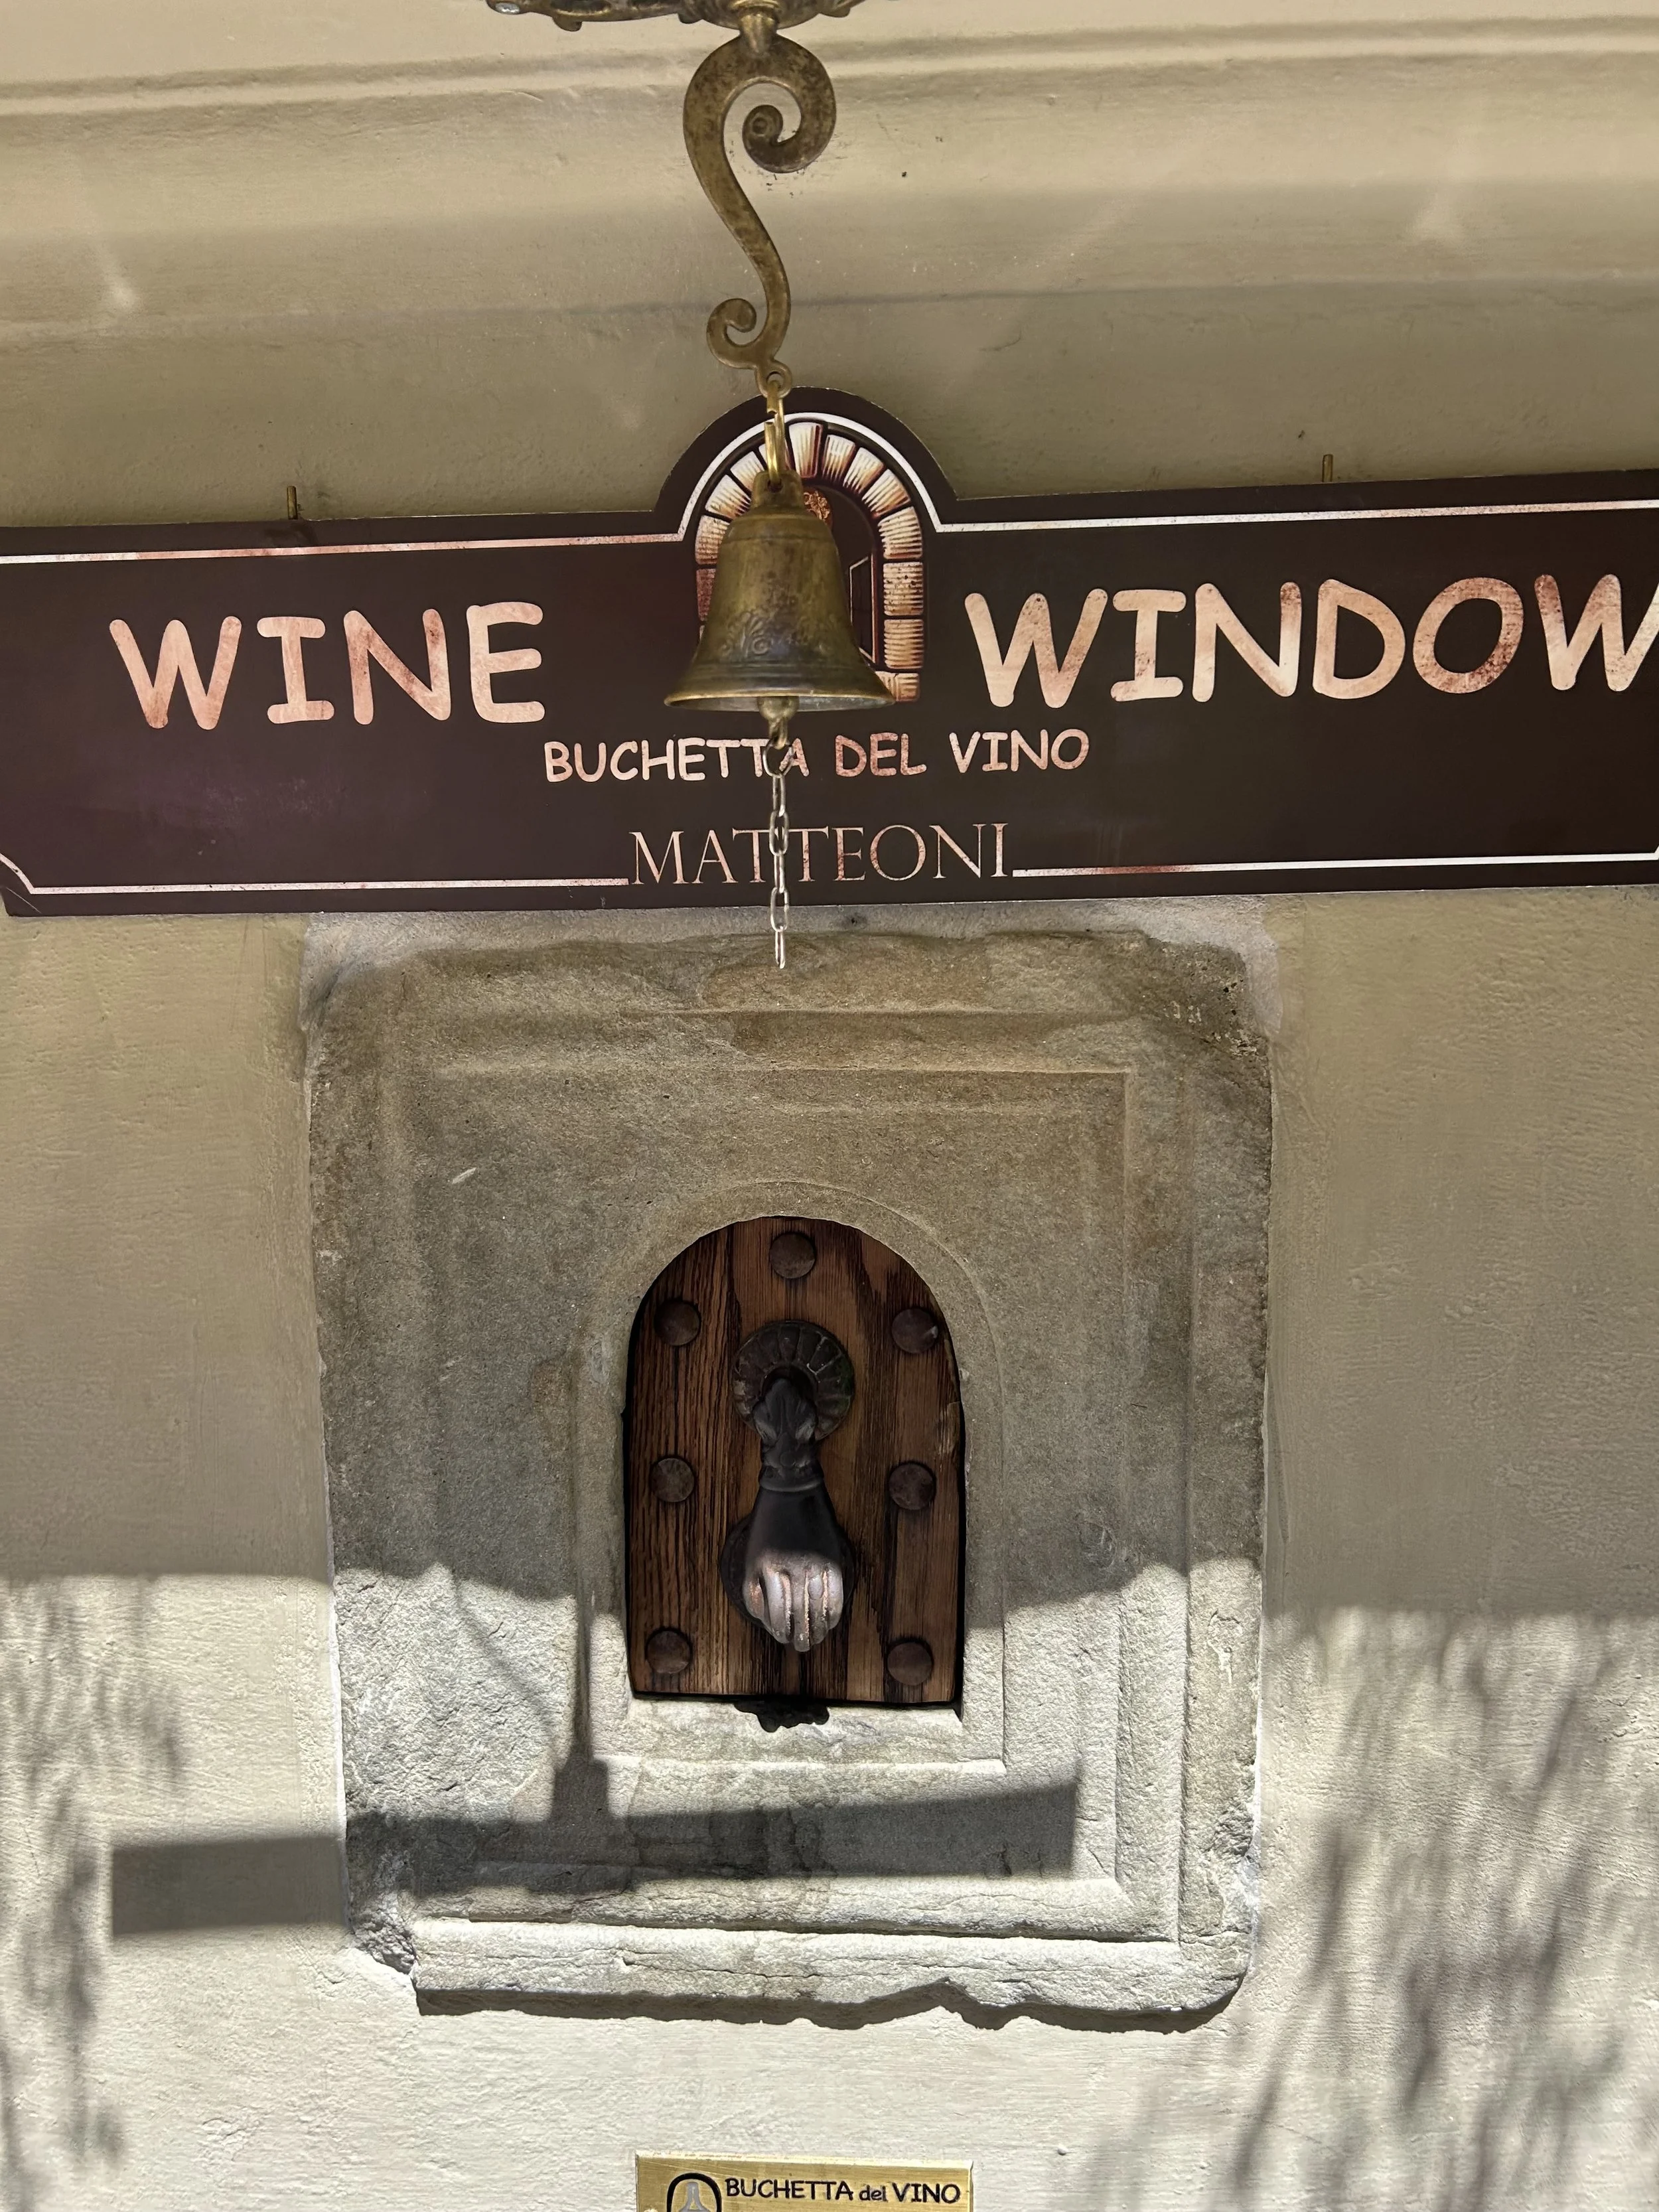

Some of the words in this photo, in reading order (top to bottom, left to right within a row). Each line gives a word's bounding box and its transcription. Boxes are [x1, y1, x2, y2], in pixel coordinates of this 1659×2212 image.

[109, 602, 545, 730] WINE
[964, 574, 1659, 709] WINDOW
[544, 737, 810, 782] BUCHETTA
[835, 732, 927, 777] DEL
[949, 729, 1090, 773] VINO
[630, 823, 1008, 885] MATTEONI
[725, 2177, 854, 2201] BUCHETTA
[859, 2185, 888, 2202] del
[892, 2183, 961, 2204] VINO
